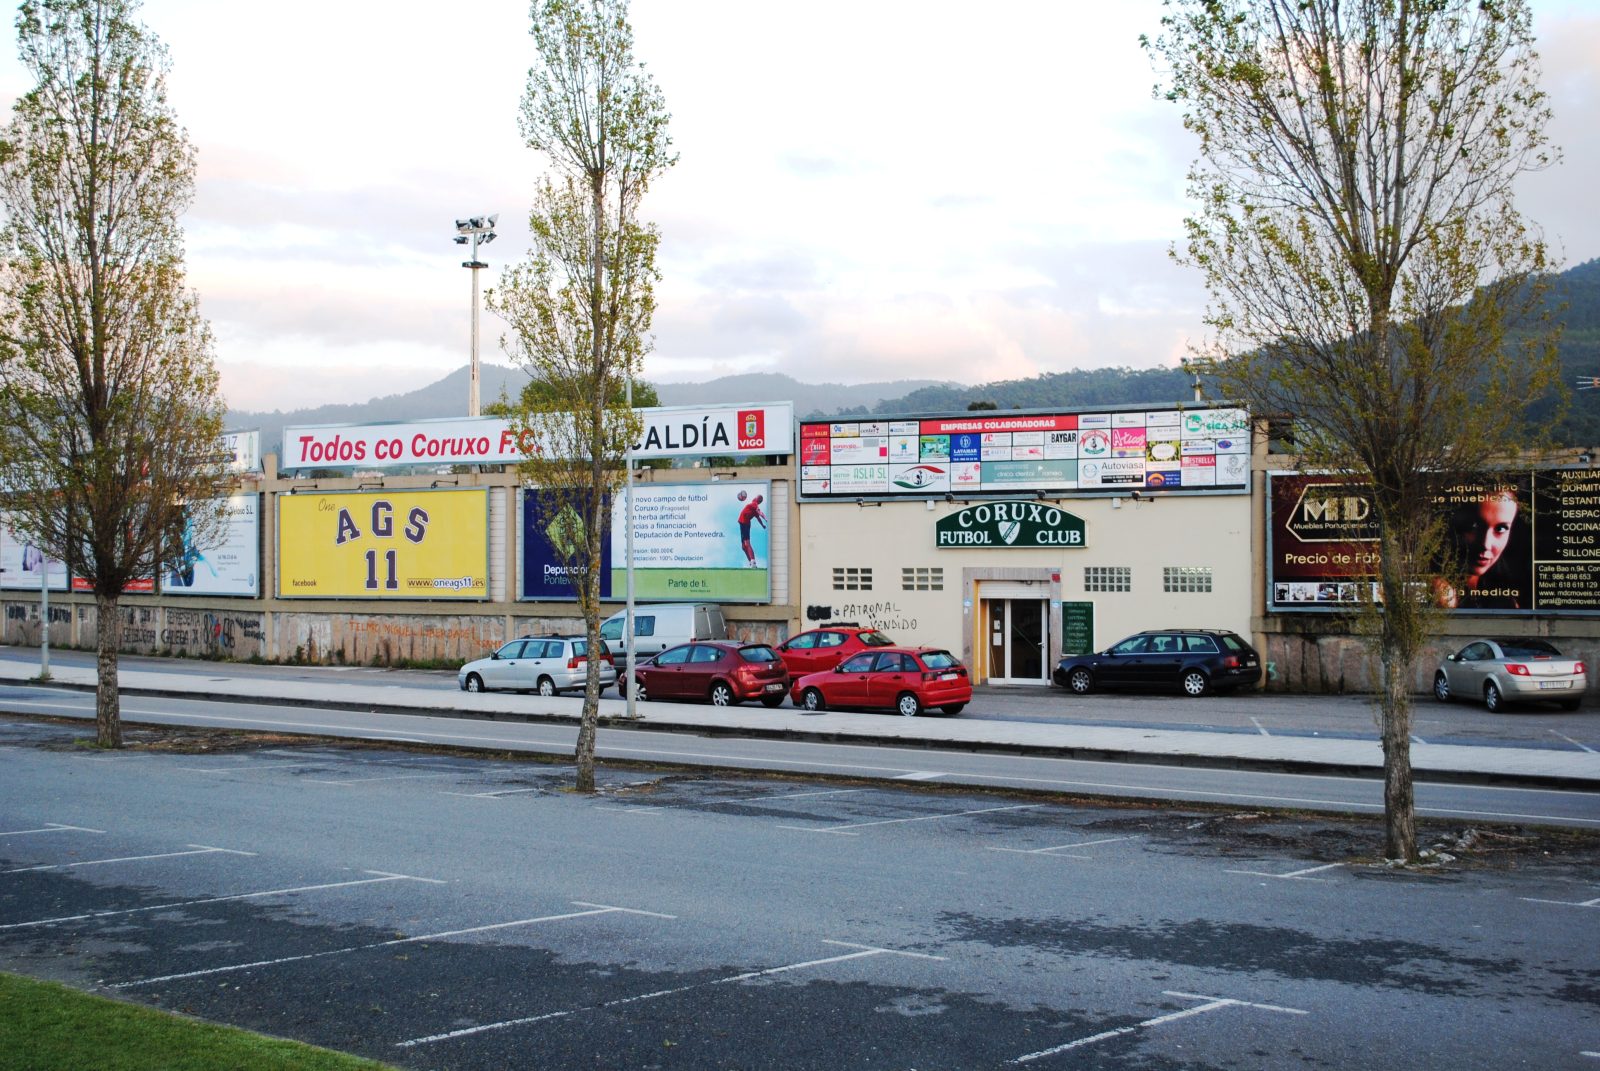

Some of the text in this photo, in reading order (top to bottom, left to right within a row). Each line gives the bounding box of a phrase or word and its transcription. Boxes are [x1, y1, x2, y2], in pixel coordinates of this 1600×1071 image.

[940, 419, 1056, 431] EMPRESAS COLABORADORAS
[631, 416, 730, 451] ALDÍA
[1051, 432, 1077, 443] BAYGAR
[299, 435, 367, 463] Todos
[375, 438, 403, 460] co
[412, 433, 490, 458] Coruxo
[739, 438, 764, 448] VIGO
[1101, 462, 1144, 470] Autoviasa
[653, 496, 677, 504] campo
[688, 494, 708, 502] fútbol
[318, 498, 336, 512] One
[638, 513, 658, 521] herba
[659, 512, 686, 520] artificial
[958, 503, 1062, 528] CORUXO
[335, 499, 431, 547] AGS
[1293, 522, 1323, 530] Muebles
[634, 531, 673, 539] Deputación
[684, 530, 726, 538] Pontevedra.
[940, 529, 1082, 545] FUTBOL CLUB
[1562, 535, 1595, 544] SILLAS
[1285, 553, 1328, 565] Precio
[1332, 553, 1351, 564] de
[365, 548, 399, 592] 11
[292, 578, 318, 588] facebook
[407, 576, 486, 592] www.oneags11.es
[668, 578, 688, 588] Parte
[690, 578, 700, 588] de
[1470, 588, 1520, 597] medida
[843, 602, 902, 618] PATRONAL
